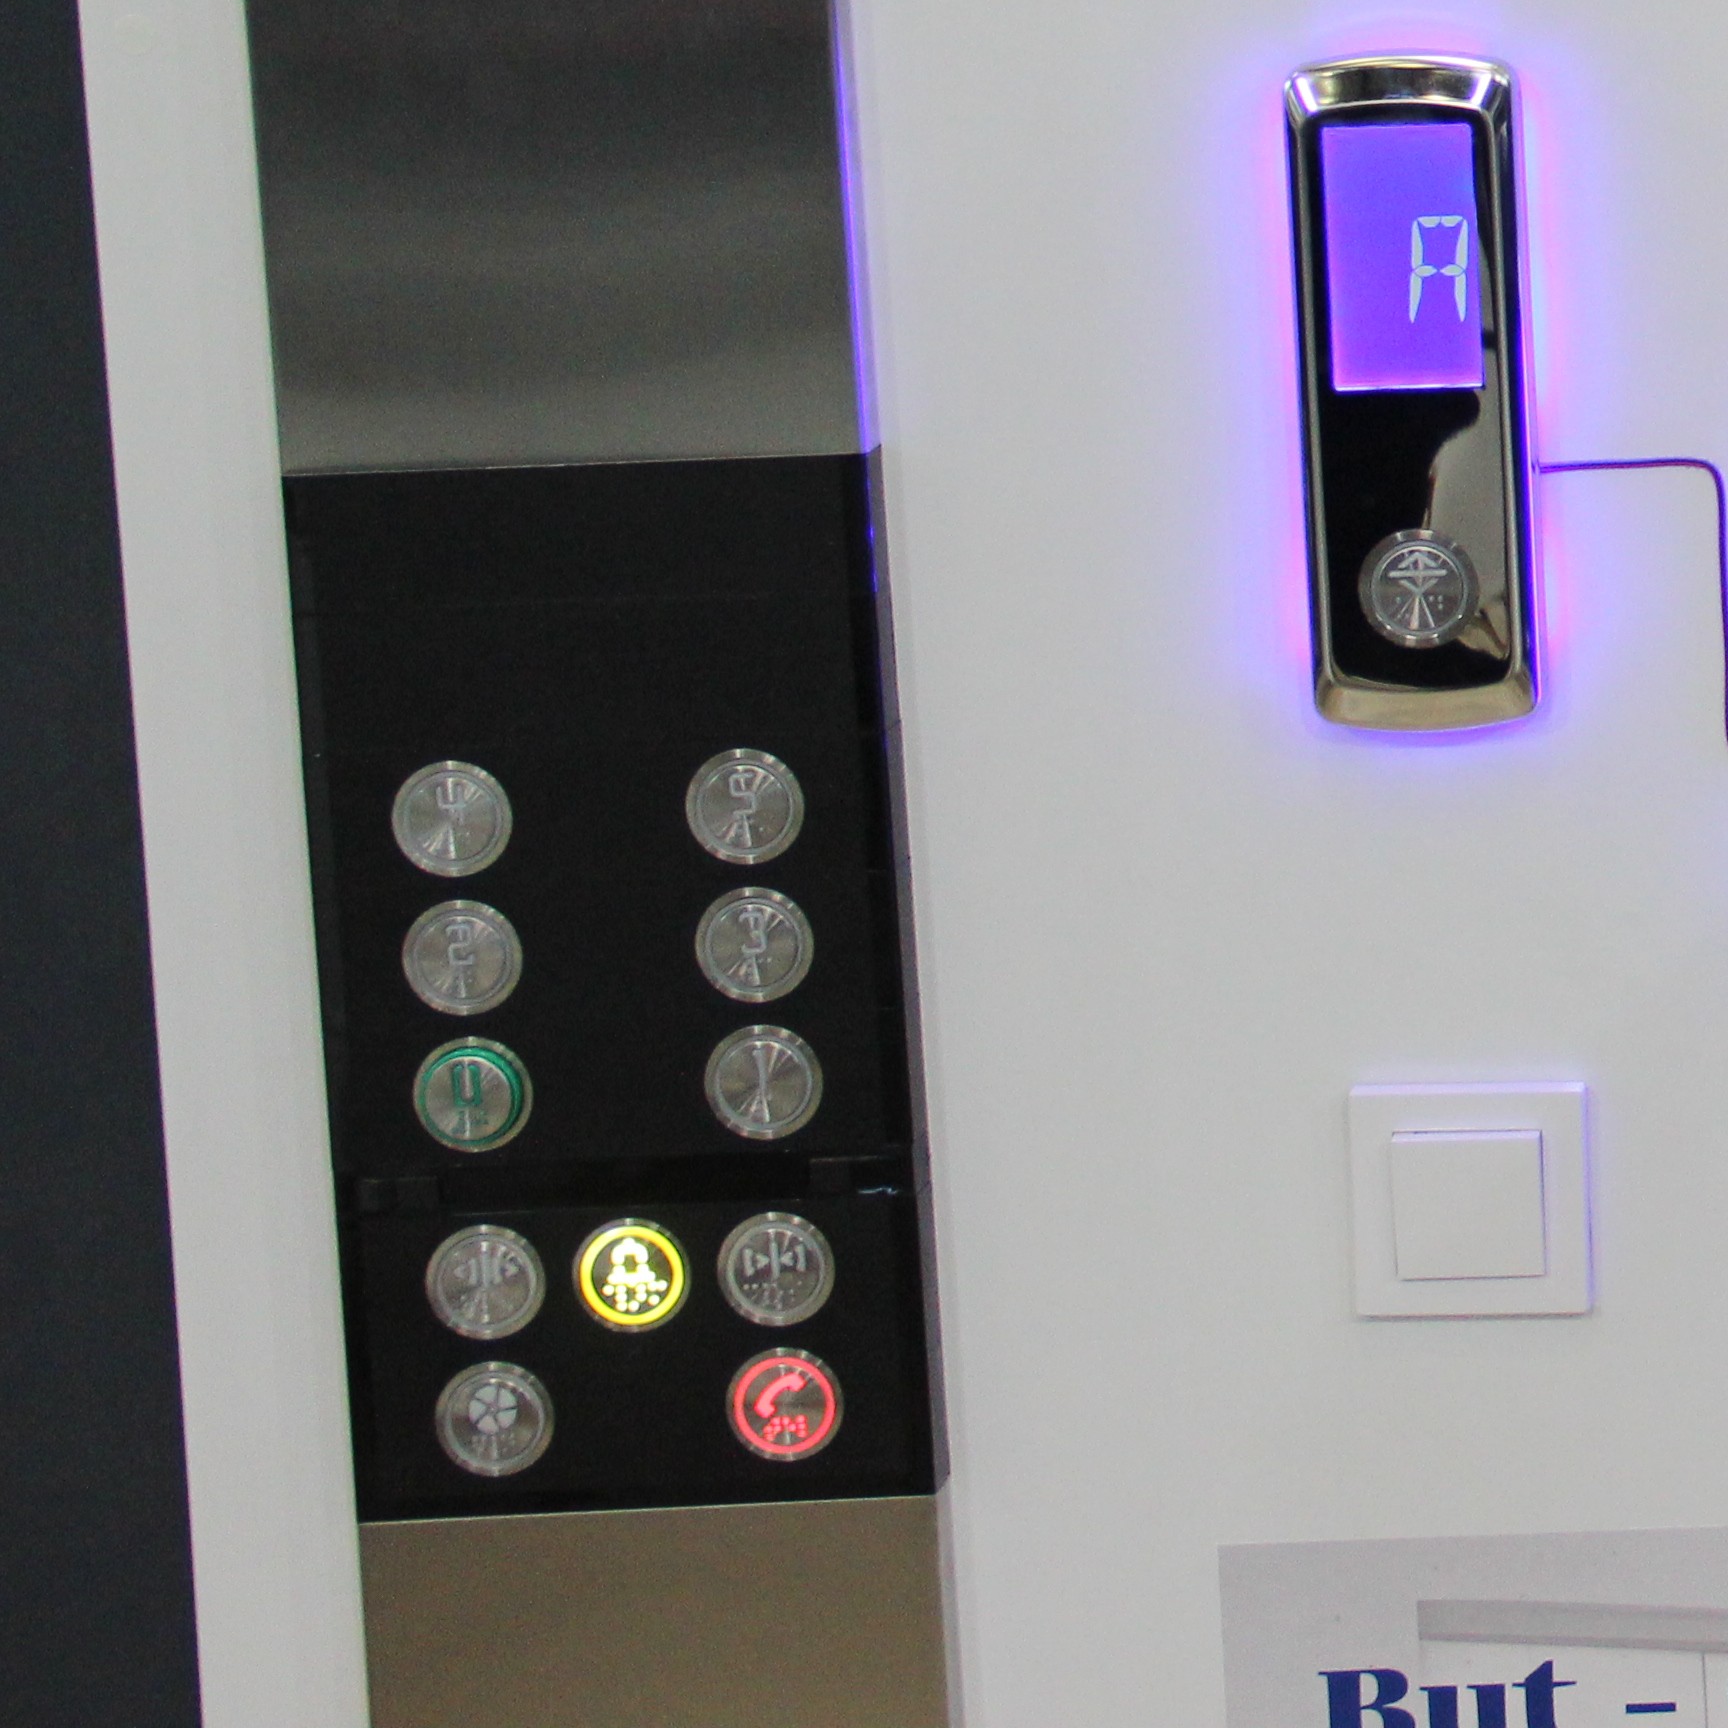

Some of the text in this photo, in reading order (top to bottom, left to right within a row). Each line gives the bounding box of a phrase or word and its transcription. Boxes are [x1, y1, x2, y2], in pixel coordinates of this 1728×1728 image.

[436, 784, 467, 825] 4
[446, 922, 475, 965] 2
[739, 912, 767, 953] 3
[1318, 1659, 1578, 1728] But
[1625, 1701, 1677, 1714] -
